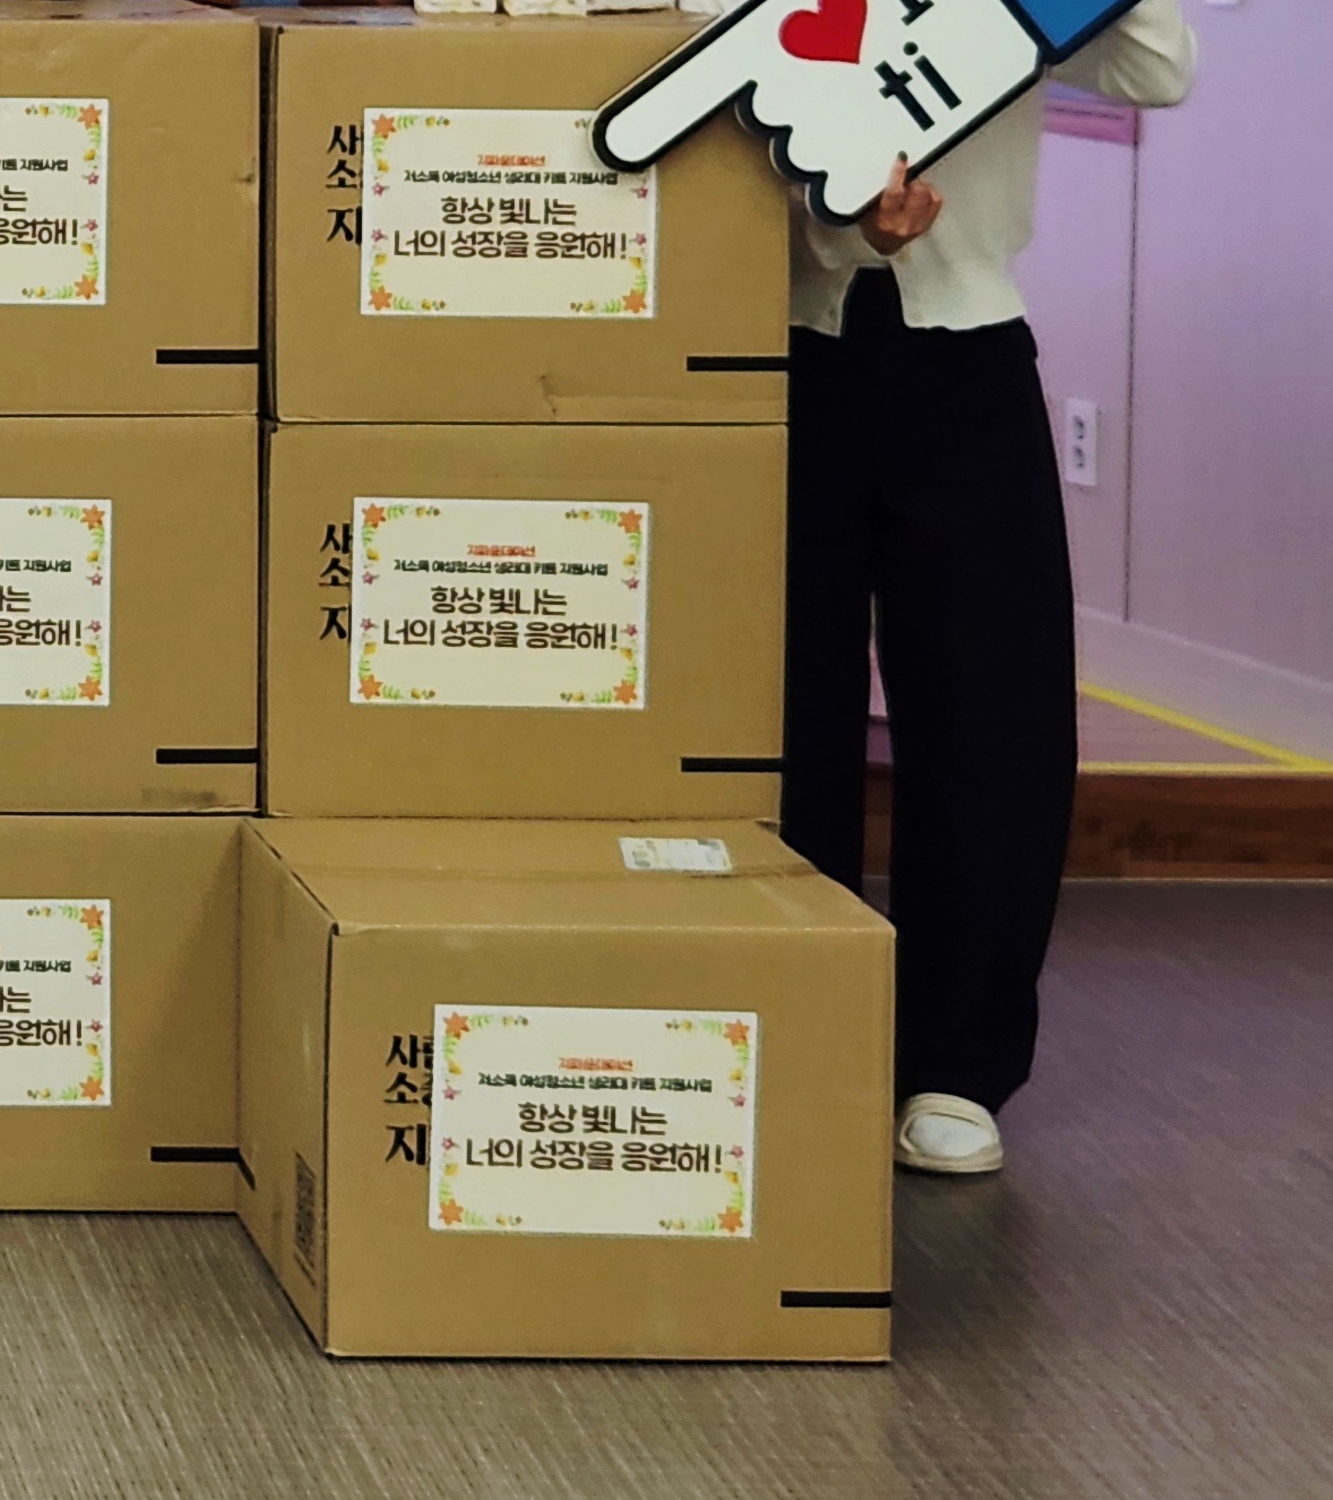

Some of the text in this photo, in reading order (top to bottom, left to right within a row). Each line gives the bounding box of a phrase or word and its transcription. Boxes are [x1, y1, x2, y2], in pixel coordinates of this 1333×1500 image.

[441, 195, 578, 227] 항상 빛나는
[394, 229, 627, 260] 너의 성장을 응원해!
[430, 585, 568, 616] 항상 빛나는
[383, 618, 618, 651] 너의 성장을 응원해!
[518, 1101, 668, 1136] 항상 빛나는
[466, 1138, 722, 1174] 너의 성장을 응원해!
